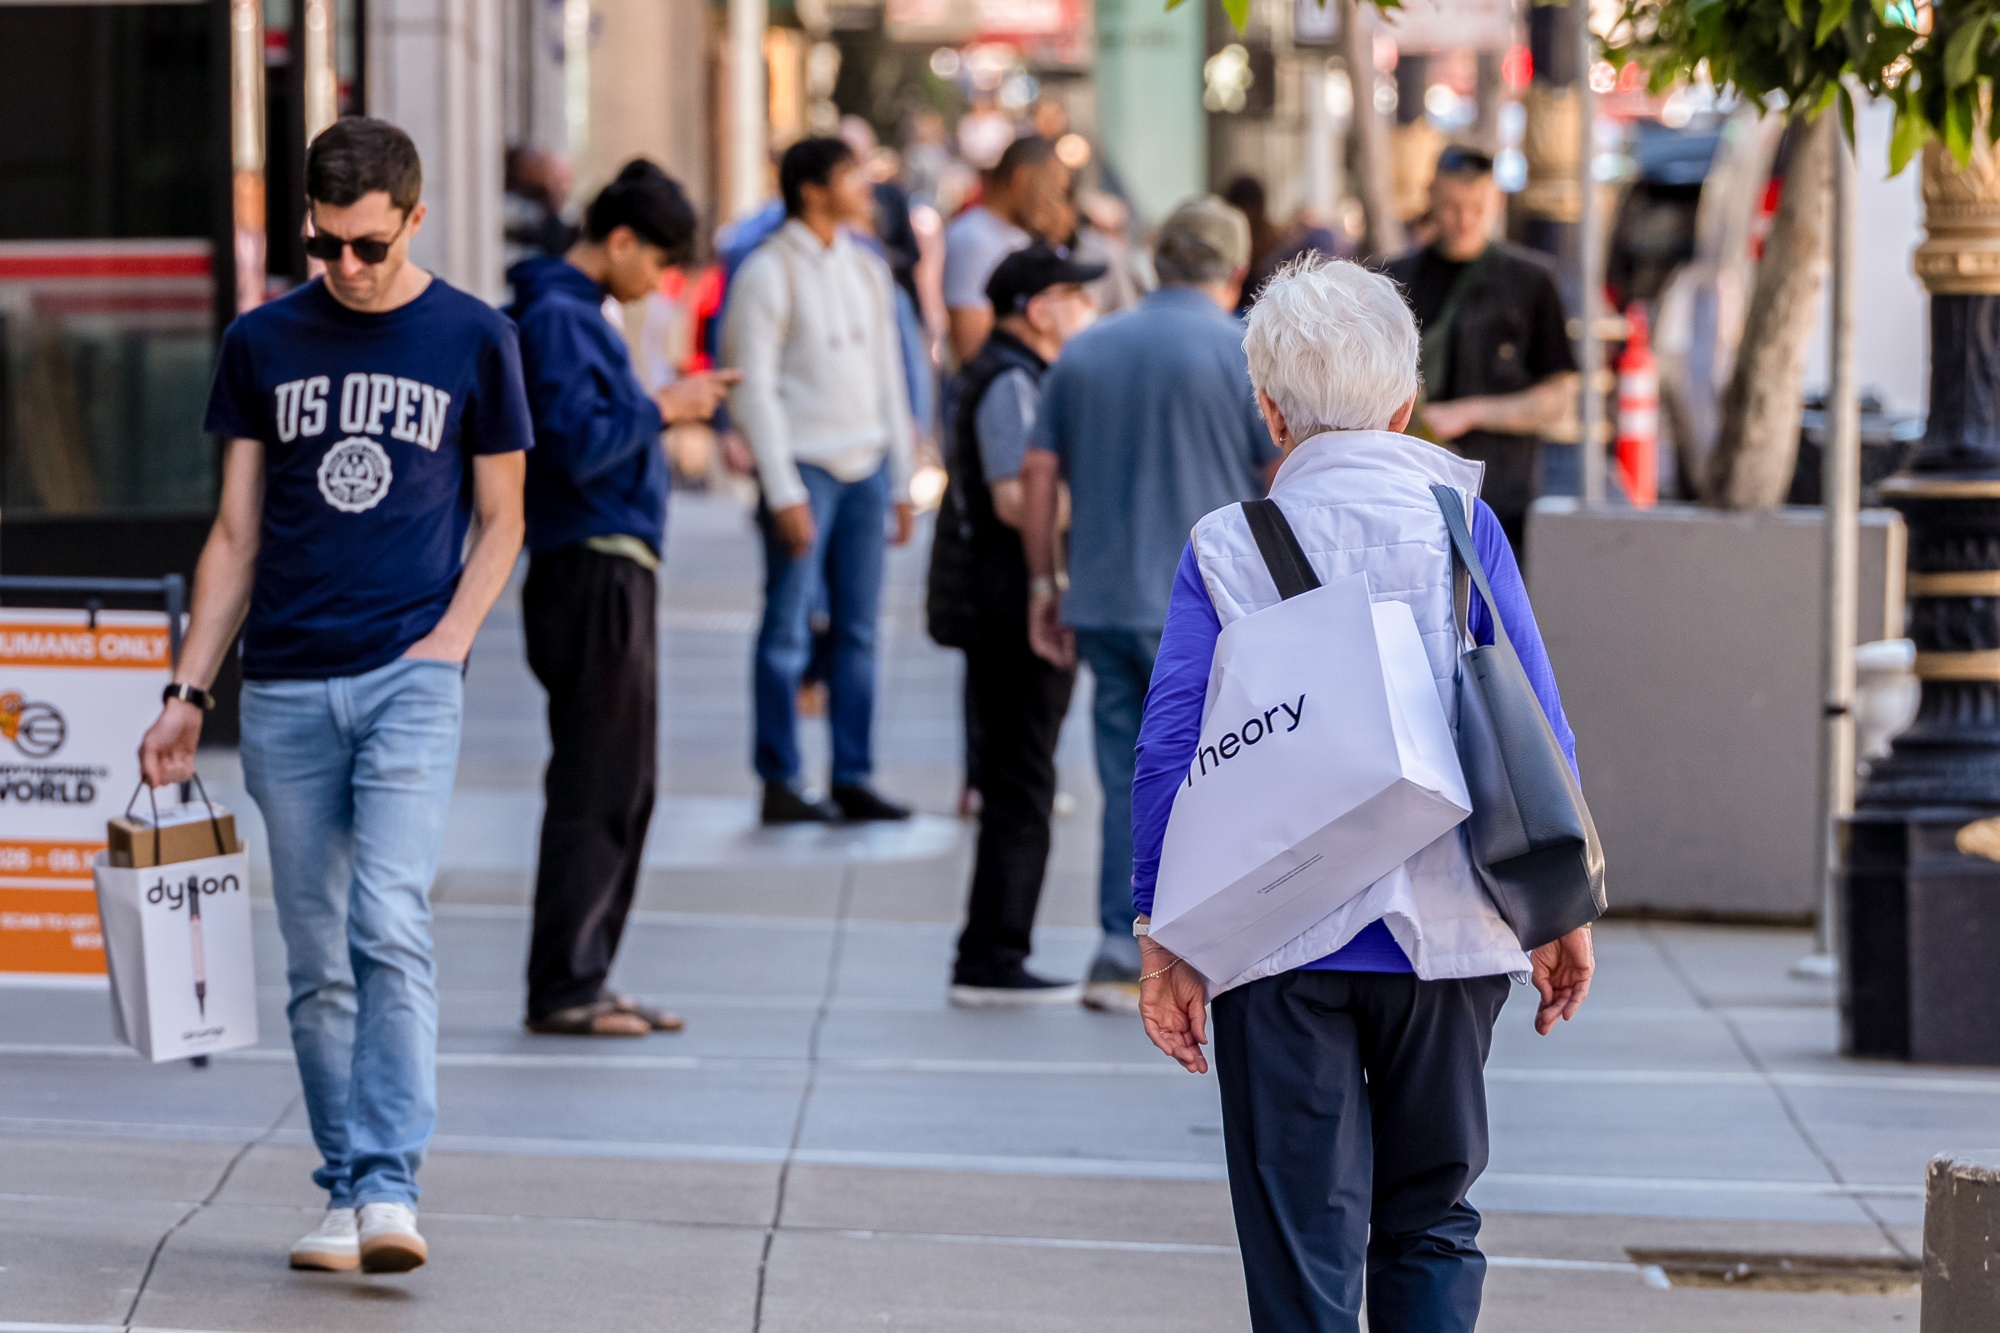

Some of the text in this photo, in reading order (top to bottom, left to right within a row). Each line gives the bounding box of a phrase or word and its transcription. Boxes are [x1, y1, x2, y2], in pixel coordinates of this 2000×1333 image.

[275, 372, 451, 452] US OPEN
[0, 632, 169, 661] UMANS ONLY
